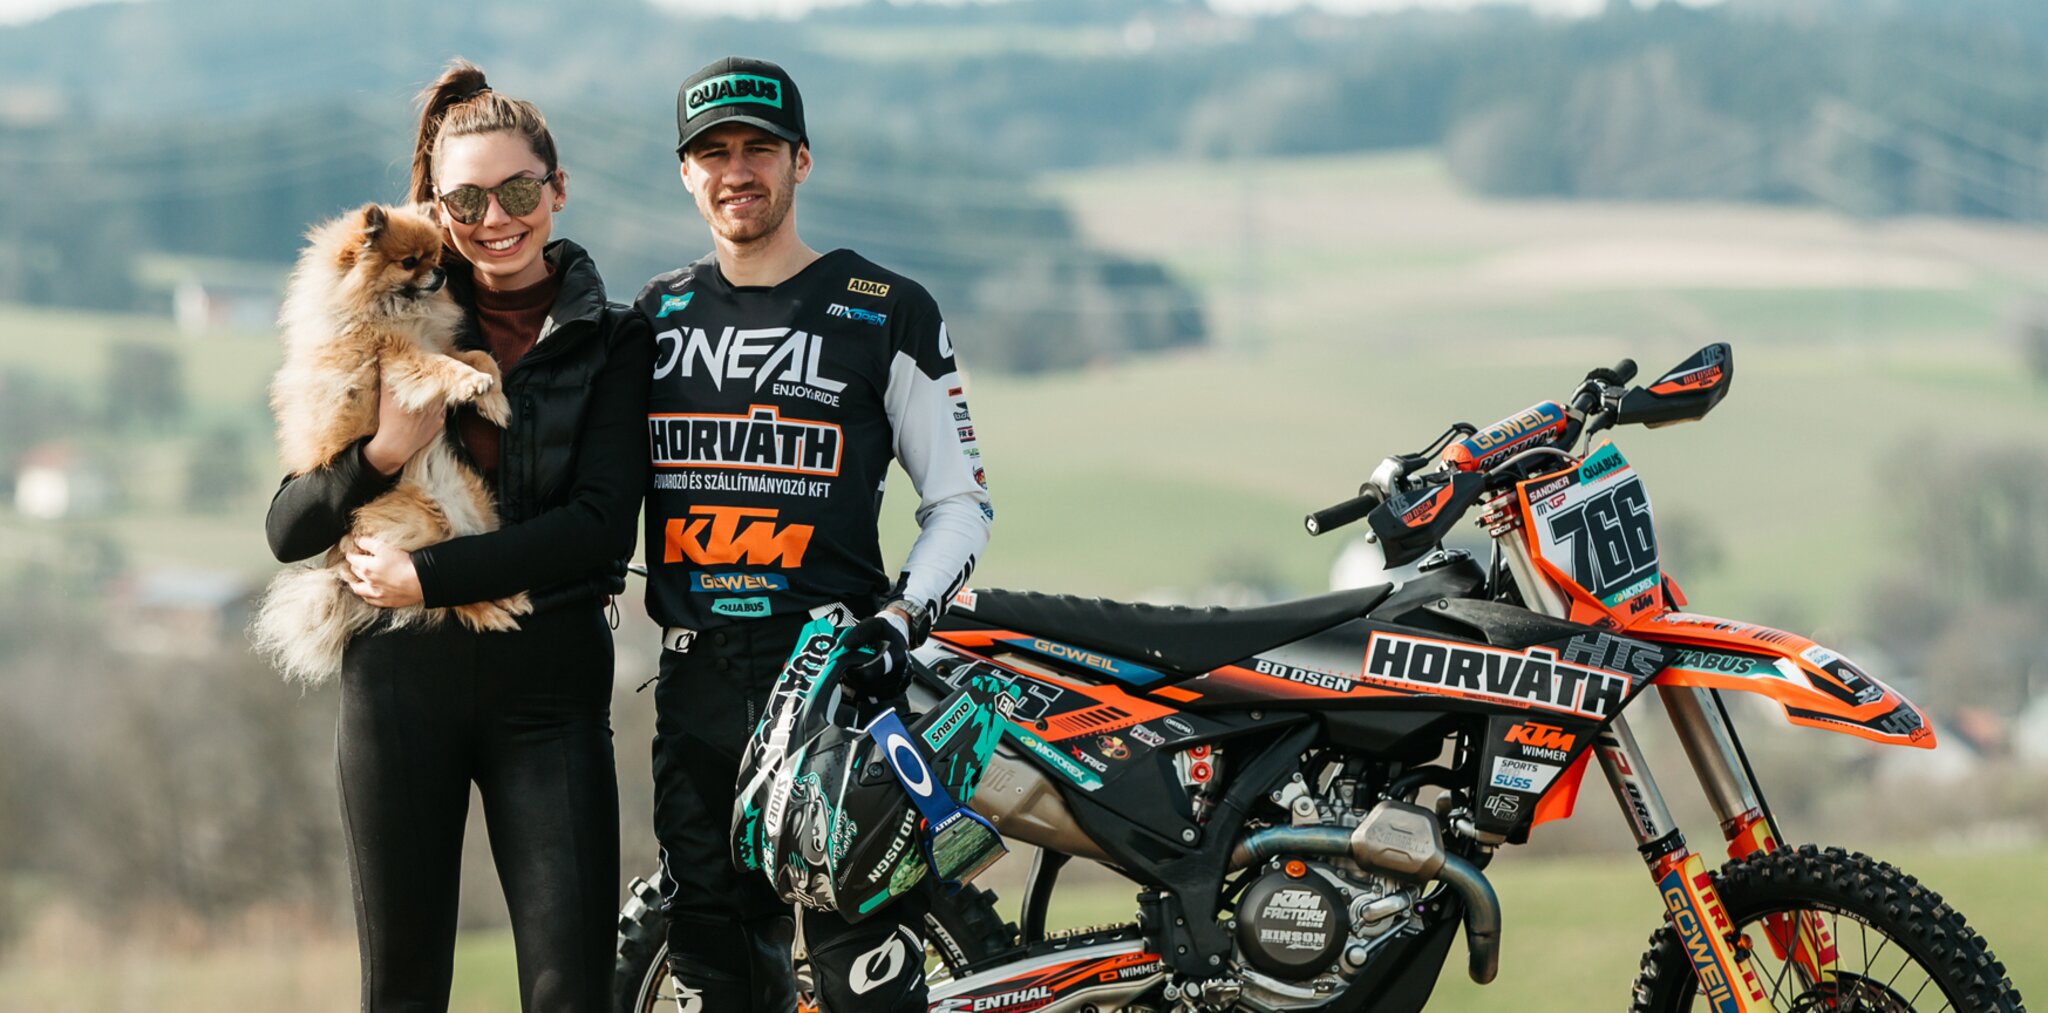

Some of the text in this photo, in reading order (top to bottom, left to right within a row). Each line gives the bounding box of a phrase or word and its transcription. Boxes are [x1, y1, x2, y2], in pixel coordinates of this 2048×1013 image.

[688, 79, 778, 109] QUABUS
[849, 280, 887, 295] ADAC
[773, 383, 812, 399] ENJOY
[814, 389, 840, 408] RIDE
[650, 411, 838, 470] HORVÁTH
[1583, 453, 1623, 480] QUABUS
[689, 471, 702, 490] ÉS
[704, 471, 806, 497] SZÁLLÍTMÁNYOZÓ
[808, 481, 832, 499] KFT
[1529, 476, 1570, 503] SANDNER
[664, 505, 815, 568] KTM
[1547, 474, 1659, 594] 766
[1623, 578, 1655, 599] MOTOREX
[1630, 593, 1654, 615] KTM
[1563, 632, 1664, 686] HTS
[1255, 659, 1351, 693] BD DSGN
[1368, 638, 1626, 717] HORVÁTH
[931, 702, 969, 743] QUABUS
[1503, 721, 1577, 753] KTM
[1035, 741, 1085, 782] MOTOREX
[1071, 744, 1109, 772] XTRIG
[1501, 759, 1538, 772] SPORTS
[1522, 744, 1567, 762] WIMMER
[767, 778, 788, 828] SHOEI
[935, 812, 962, 833] OAKLEY
[867, 808, 917, 884] BD DSGN
[1269, 889, 1321, 910] KTM
[1262, 906, 1328, 922] FACTORY
[1261, 928, 1327, 944] HINSON
